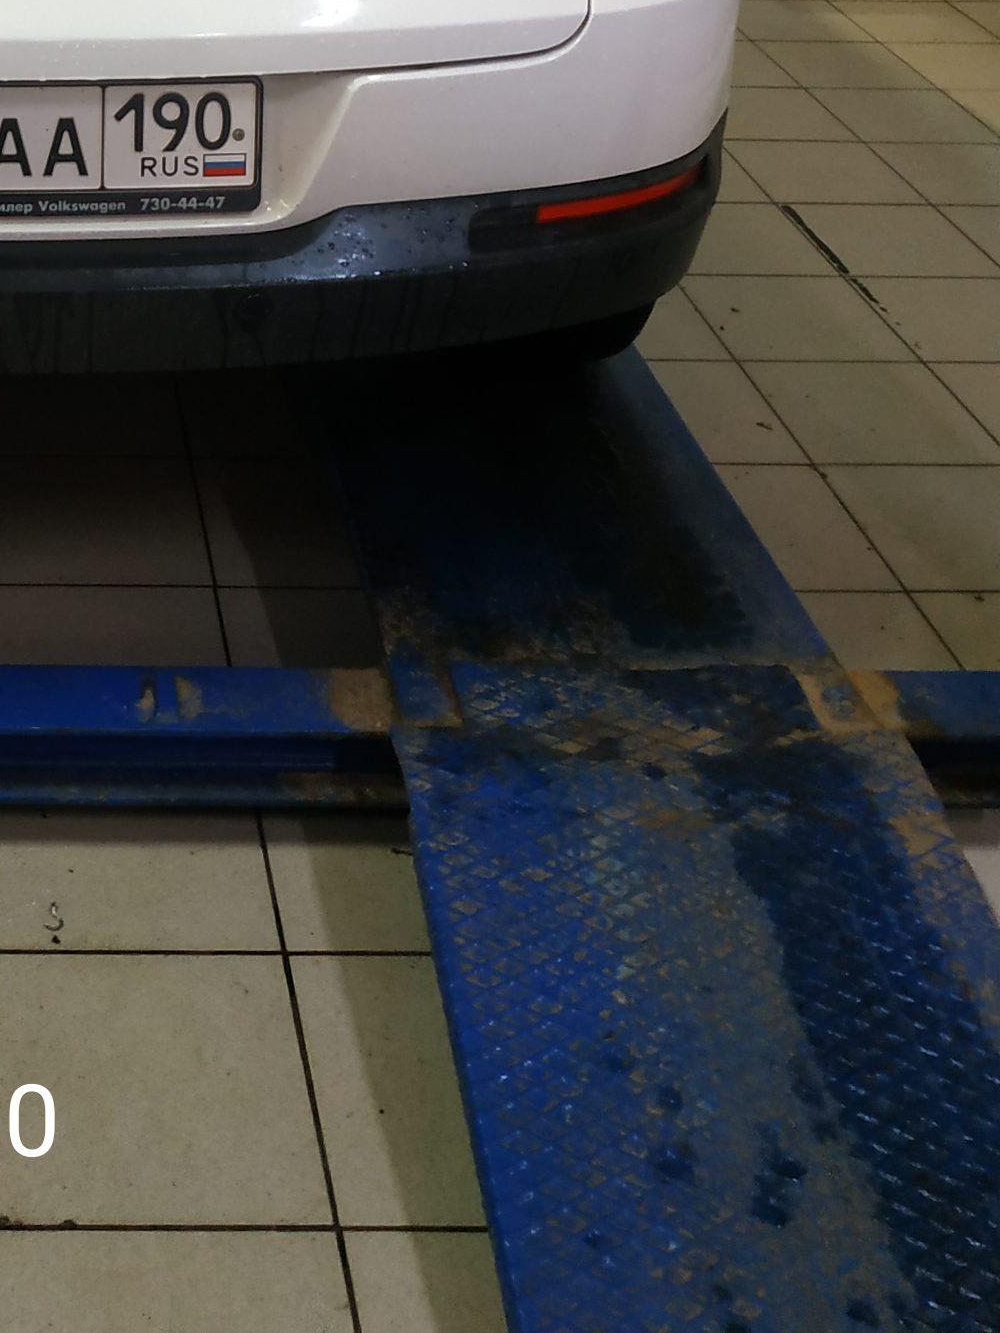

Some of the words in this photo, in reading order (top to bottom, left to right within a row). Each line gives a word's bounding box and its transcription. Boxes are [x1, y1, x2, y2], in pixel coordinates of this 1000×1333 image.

[114, 92, 232, 153] 190
[140, 157, 200, 178] RUS
[38, 200, 126, 213] Volkswagen
[140, 196, 226, 211] 730-44-47
